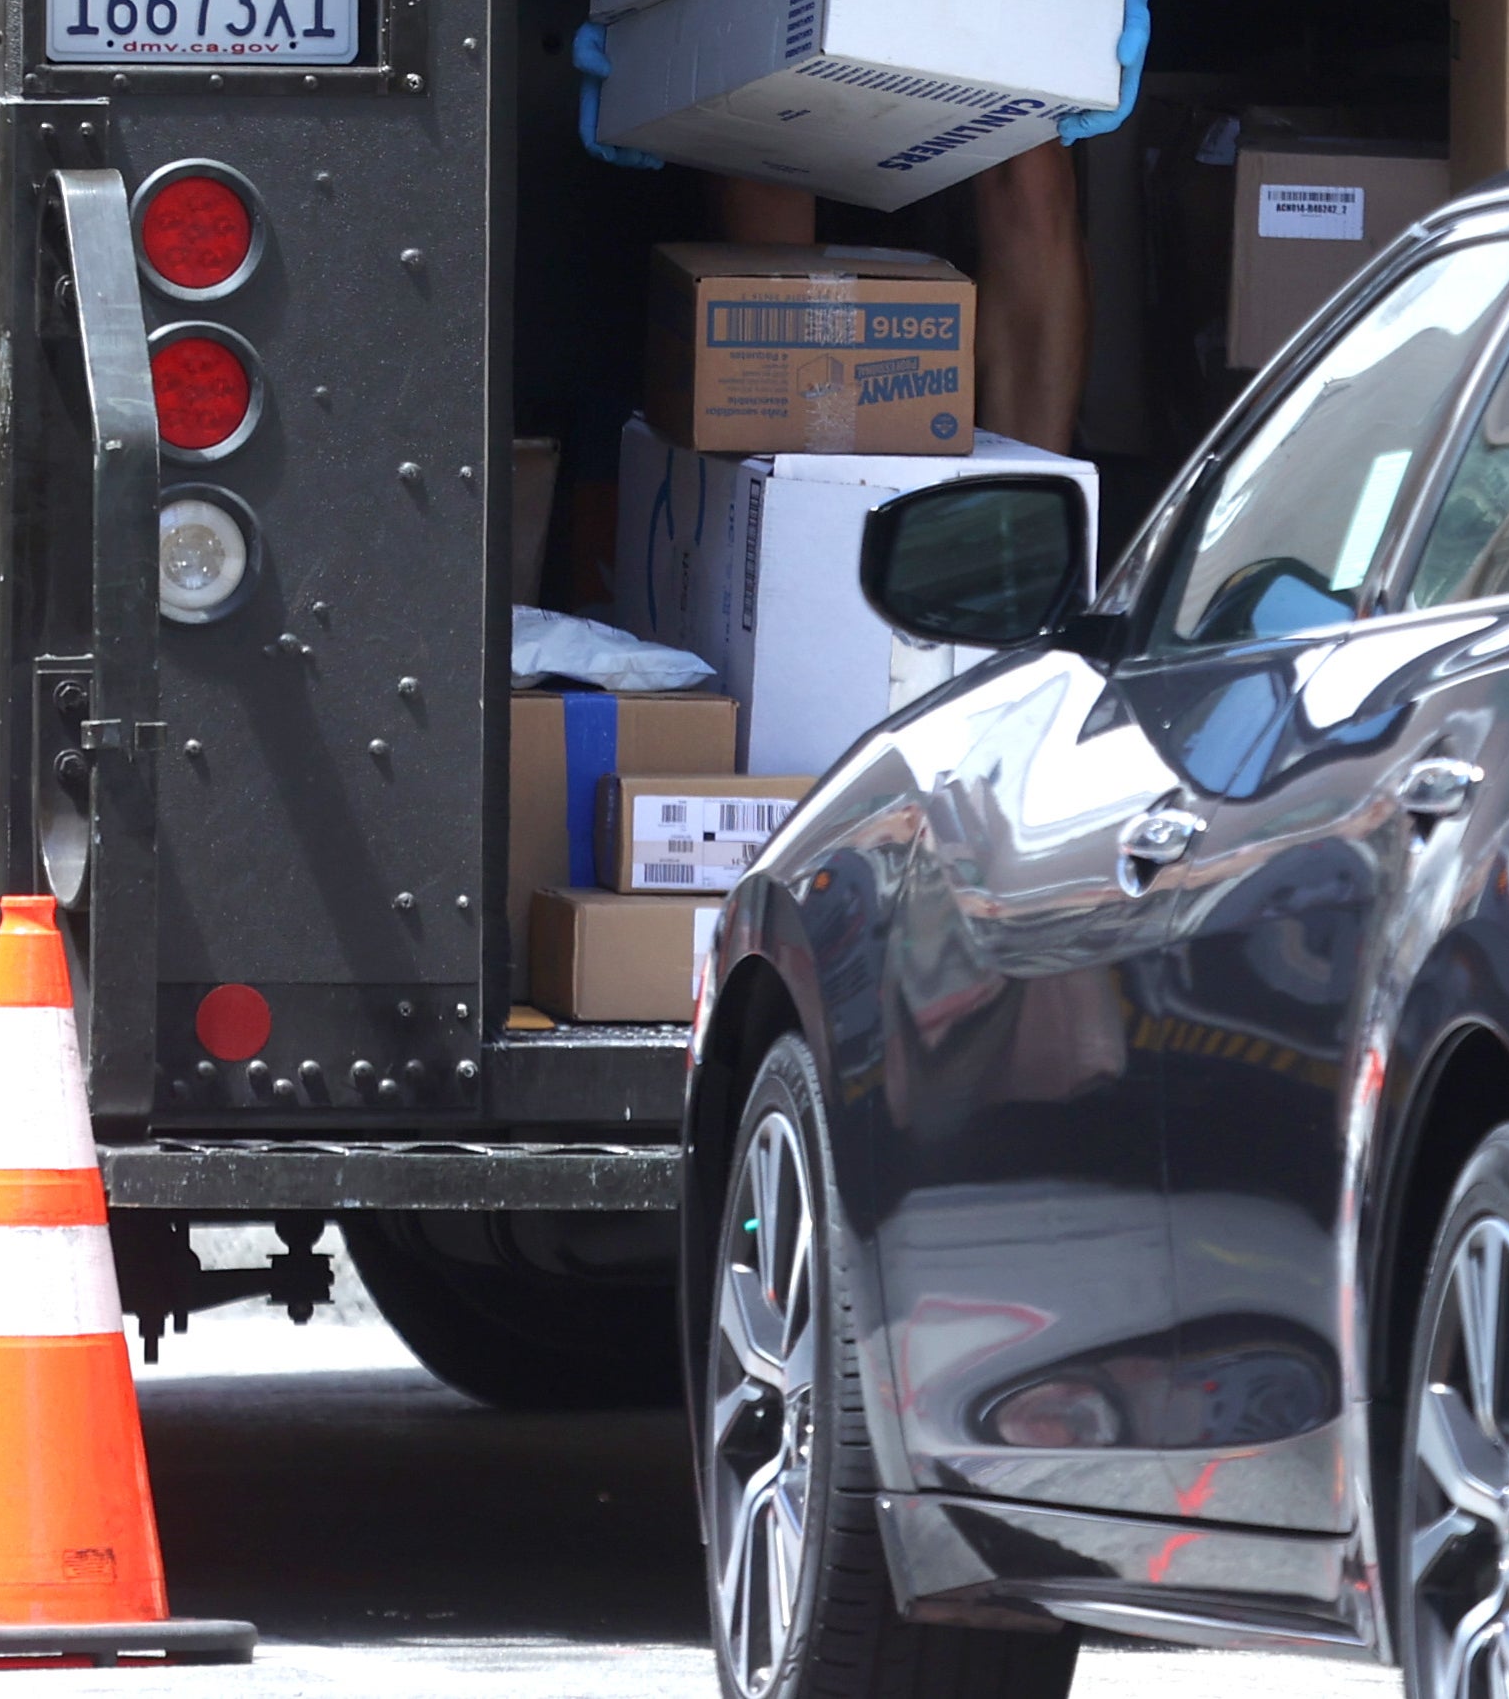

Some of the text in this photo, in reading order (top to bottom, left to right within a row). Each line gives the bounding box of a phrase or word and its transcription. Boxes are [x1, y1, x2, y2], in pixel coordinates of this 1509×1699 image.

[122, 40, 280, 54] dmv.ca.gov
[971, 99, 1046, 128] CAN
[877, 124, 994, 171] LINERS
[872, 315, 956, 340] 29616
[858, 366, 959, 406] BRAWNY
